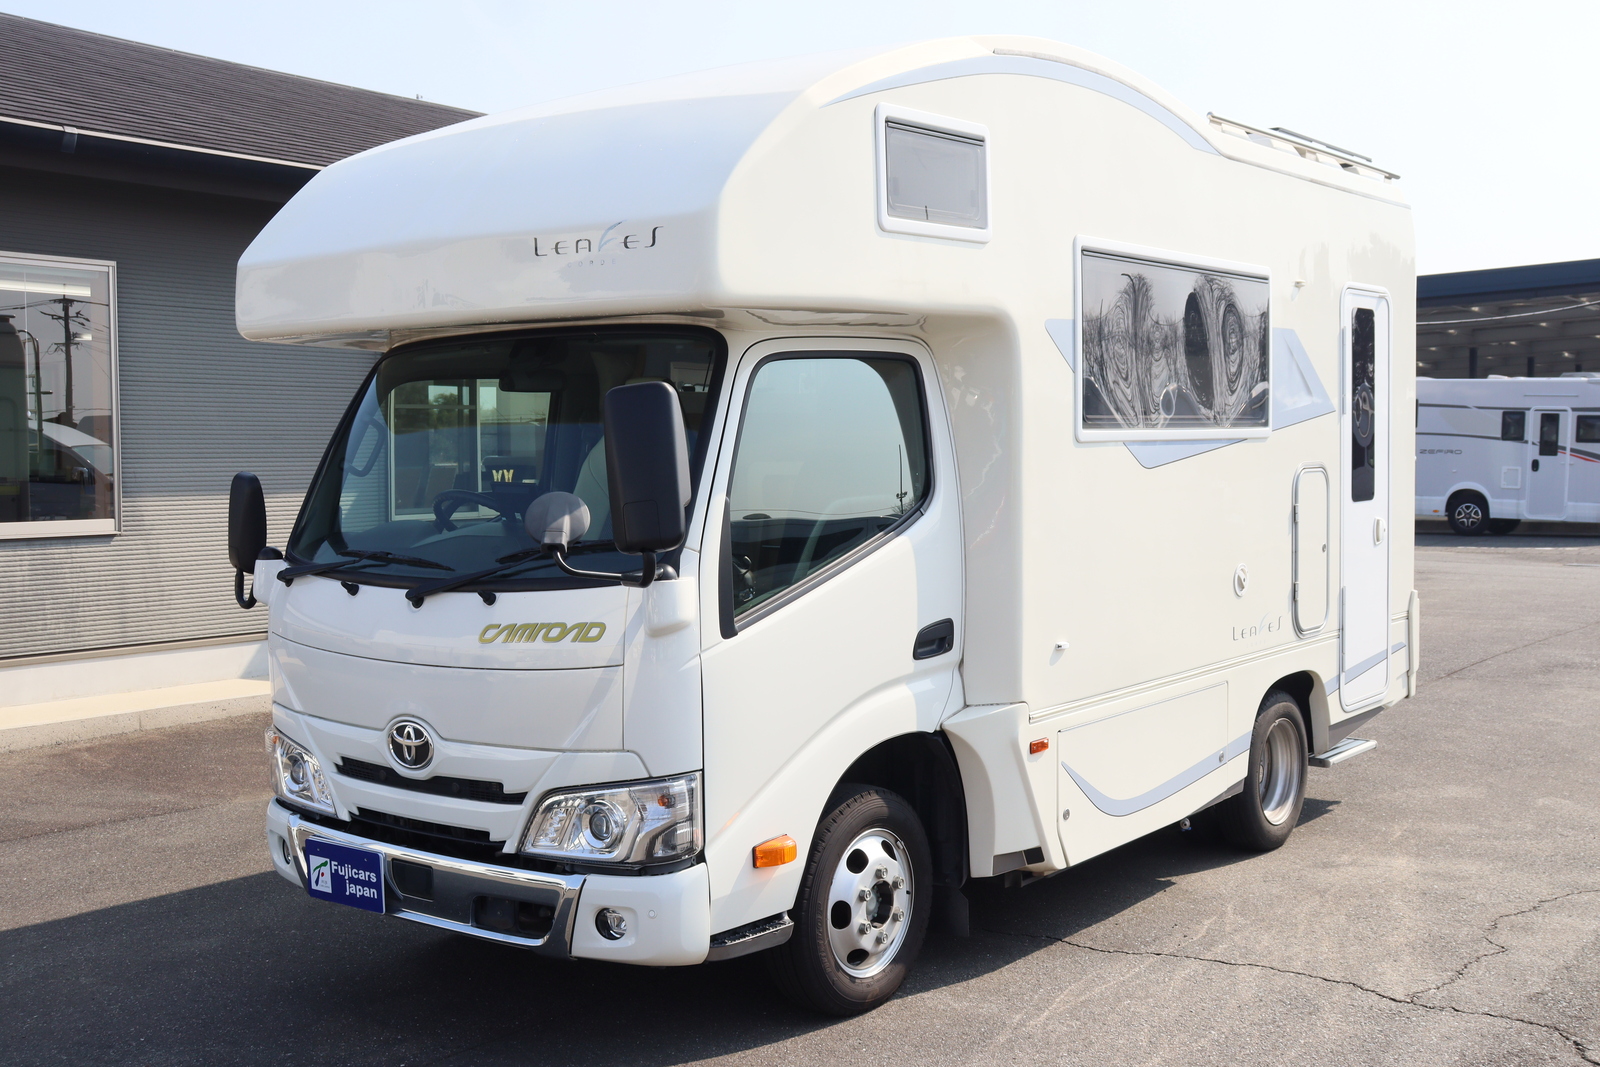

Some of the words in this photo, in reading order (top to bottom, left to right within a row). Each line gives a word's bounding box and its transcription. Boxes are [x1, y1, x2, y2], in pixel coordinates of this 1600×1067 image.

[478, 622, 607, 644] CAMROAD
[331, 860, 377, 883] Fujicars
[345, 880, 378, 899] japan
